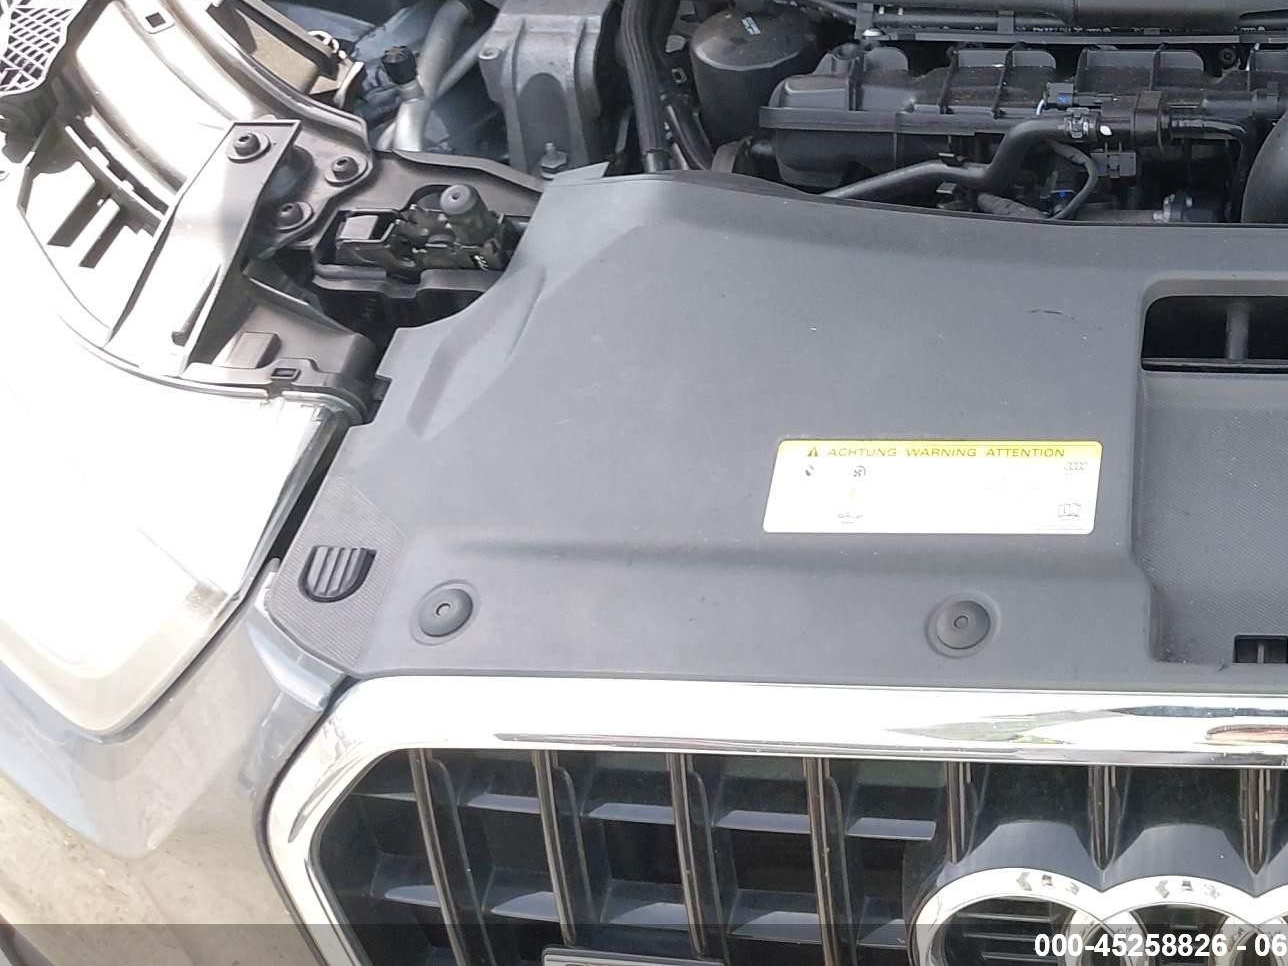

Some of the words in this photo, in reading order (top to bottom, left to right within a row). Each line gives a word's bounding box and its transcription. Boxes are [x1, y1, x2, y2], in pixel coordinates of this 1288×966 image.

[827, 447, 897, 457] ACHTUNG
[906, 447, 977, 457] WARNING
[985, 447, 1065, 457] ATTENTION
